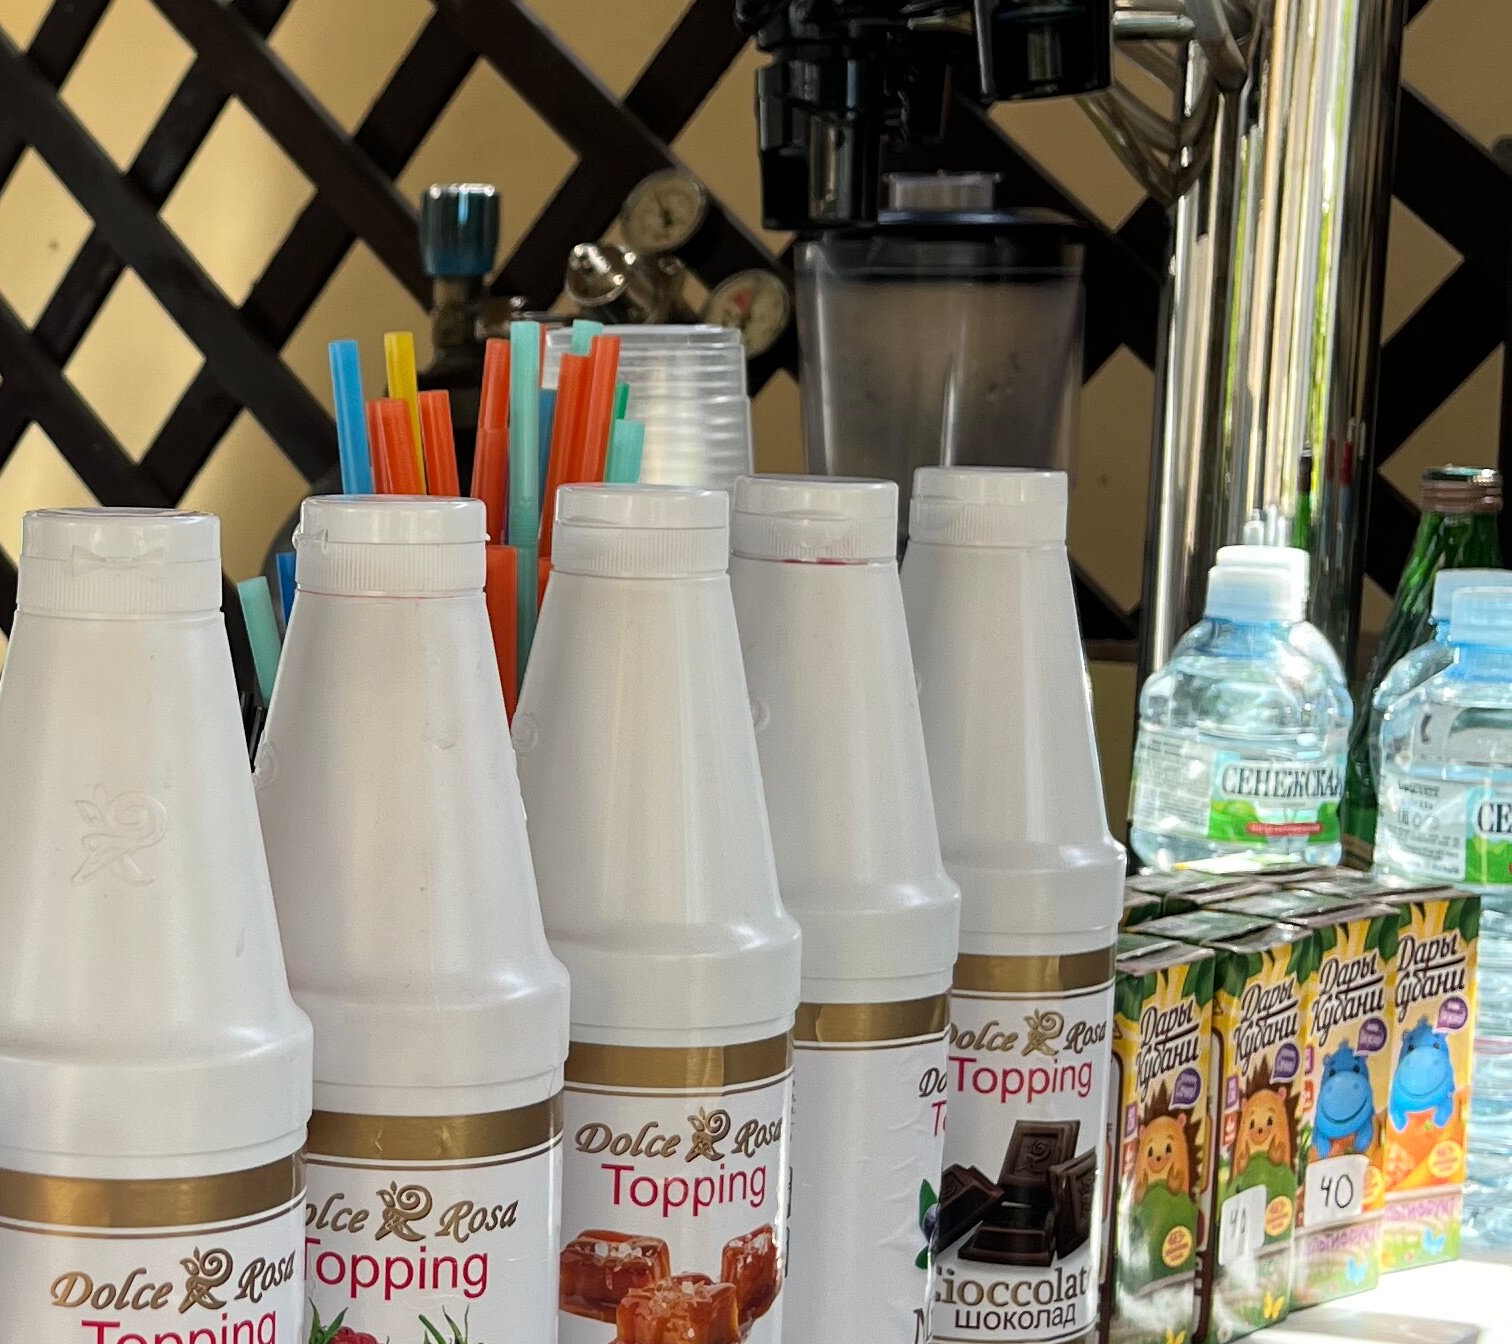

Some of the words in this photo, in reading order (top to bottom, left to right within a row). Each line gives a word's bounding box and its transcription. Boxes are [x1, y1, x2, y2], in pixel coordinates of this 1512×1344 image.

[1319, 953, 1378, 998] Дары
[1397, 933, 1460, 974] Дары
[1140, 999, 1194, 1048] Дары
[1240, 980, 1294, 1024] Дары
[1311, 987, 1384, 1047] Кубани
[1234, 1011, 1298, 1076] Кубани
[949, 1056, 1093, 1104] Topping
[1136, 1036, 1199, 1102] Кубани
[574, 1120, 682, 1158] Dolce
[600, 1163, 767, 1218] Topping
[1320, 1174, 1354, 1209] 40
[434, 1199, 520, 1244] Rosa
[50, 1267, 175, 1310] Dolce
[233, 1249, 297, 1303] Rosa
[954, 1303, 1077, 1330] шоколад
